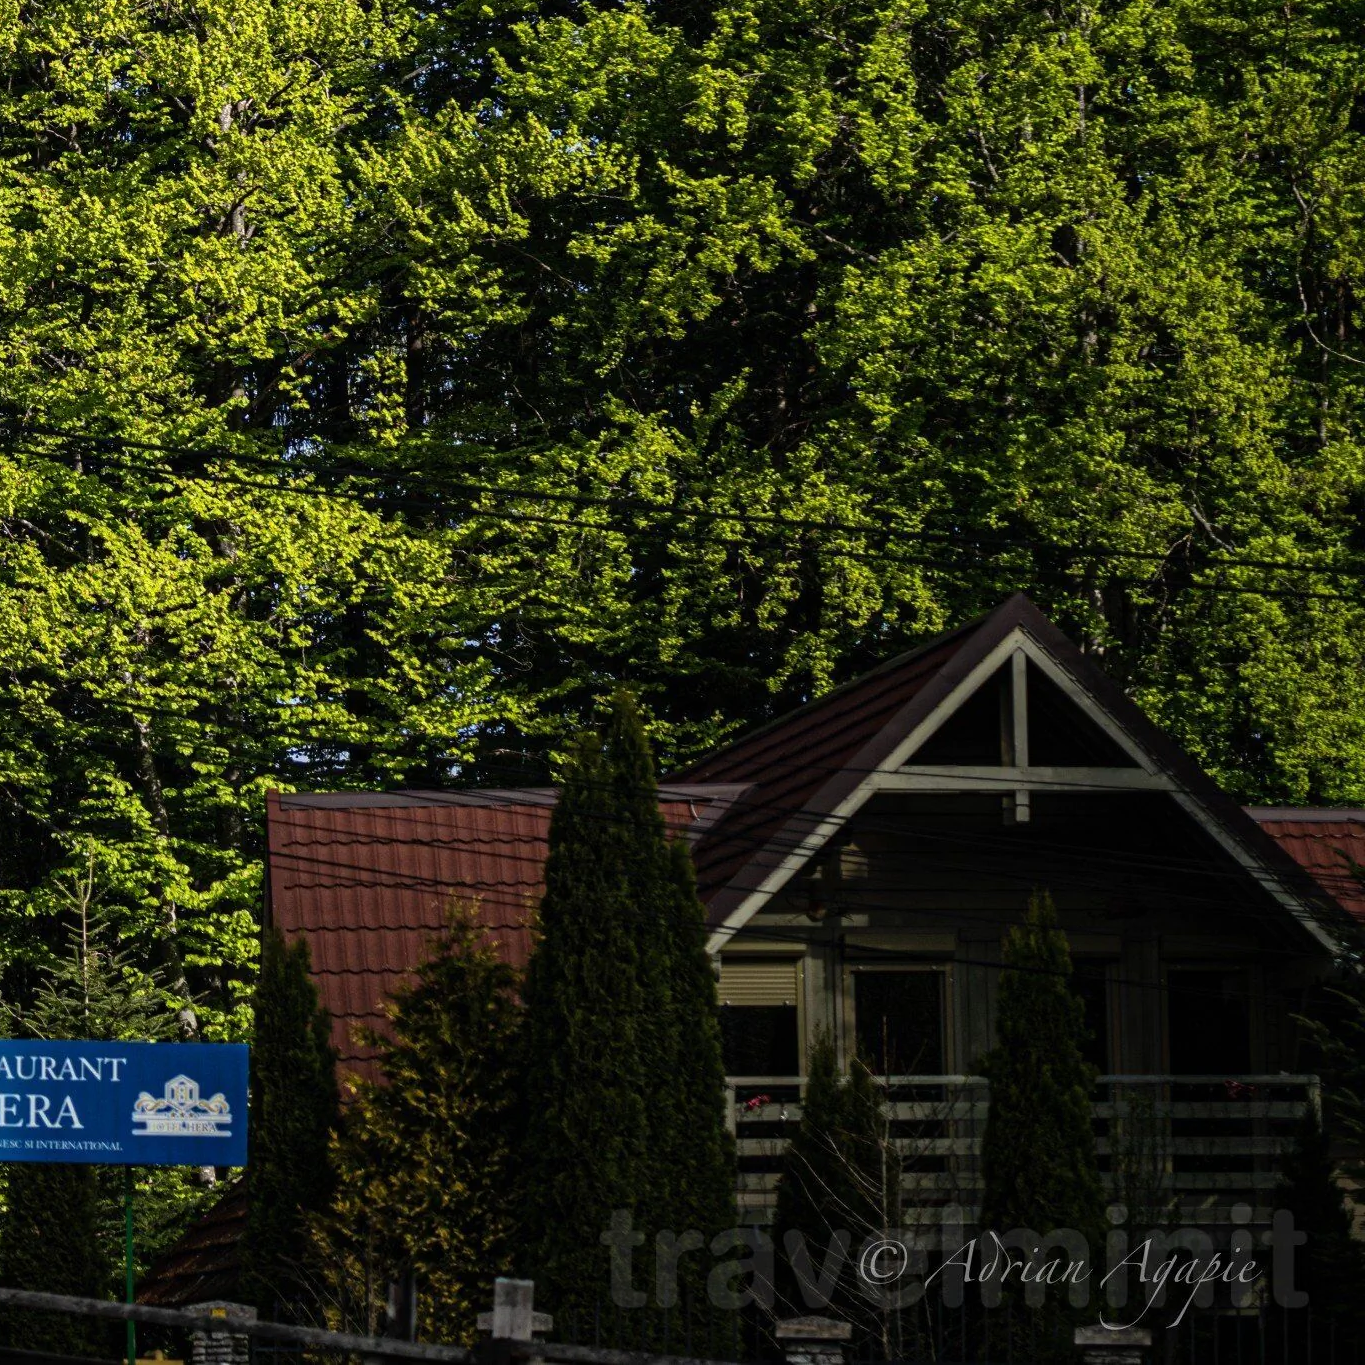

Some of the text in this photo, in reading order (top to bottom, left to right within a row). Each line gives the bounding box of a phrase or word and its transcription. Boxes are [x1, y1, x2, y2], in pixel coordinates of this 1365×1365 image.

[186, 1121, 217, 1132] HERA
[24, 1140, 34, 1149] SI
[36, 1140, 123, 1152] INTERNATIONAL
